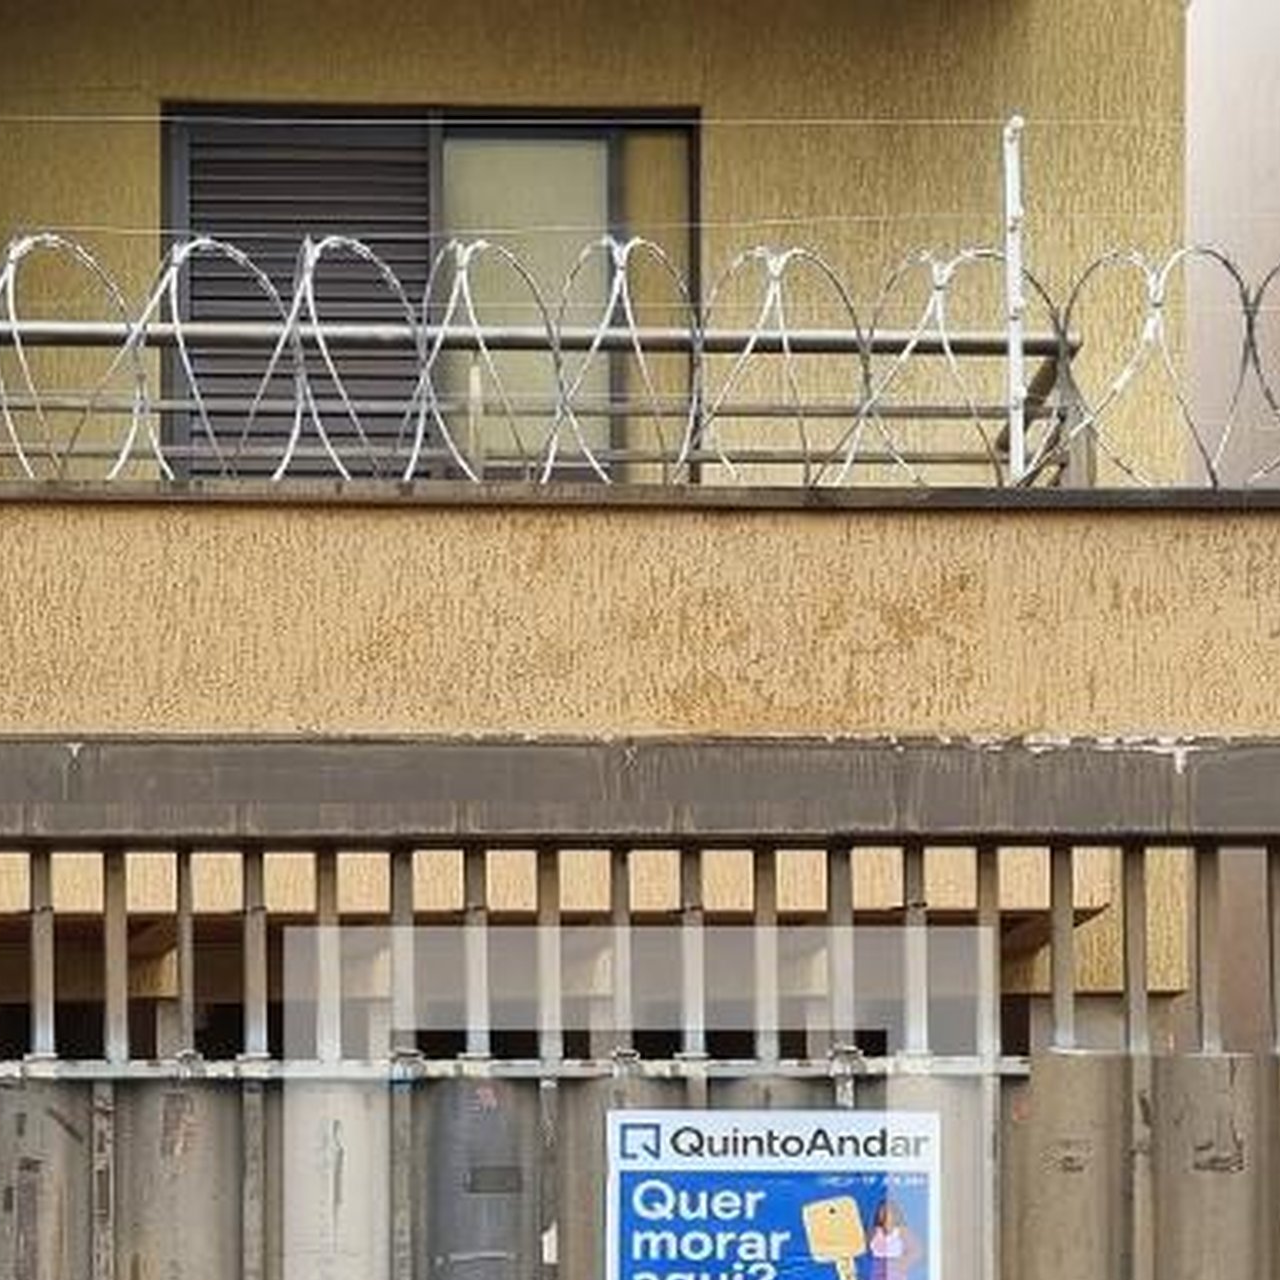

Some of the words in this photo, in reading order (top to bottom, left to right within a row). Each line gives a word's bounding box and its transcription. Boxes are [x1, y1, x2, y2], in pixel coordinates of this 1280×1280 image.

[669, 1126, 929, 1160] QuintoAndar
[632, 1180, 766, 1220] Quer
[632, 1230, 790, 1261] morar
